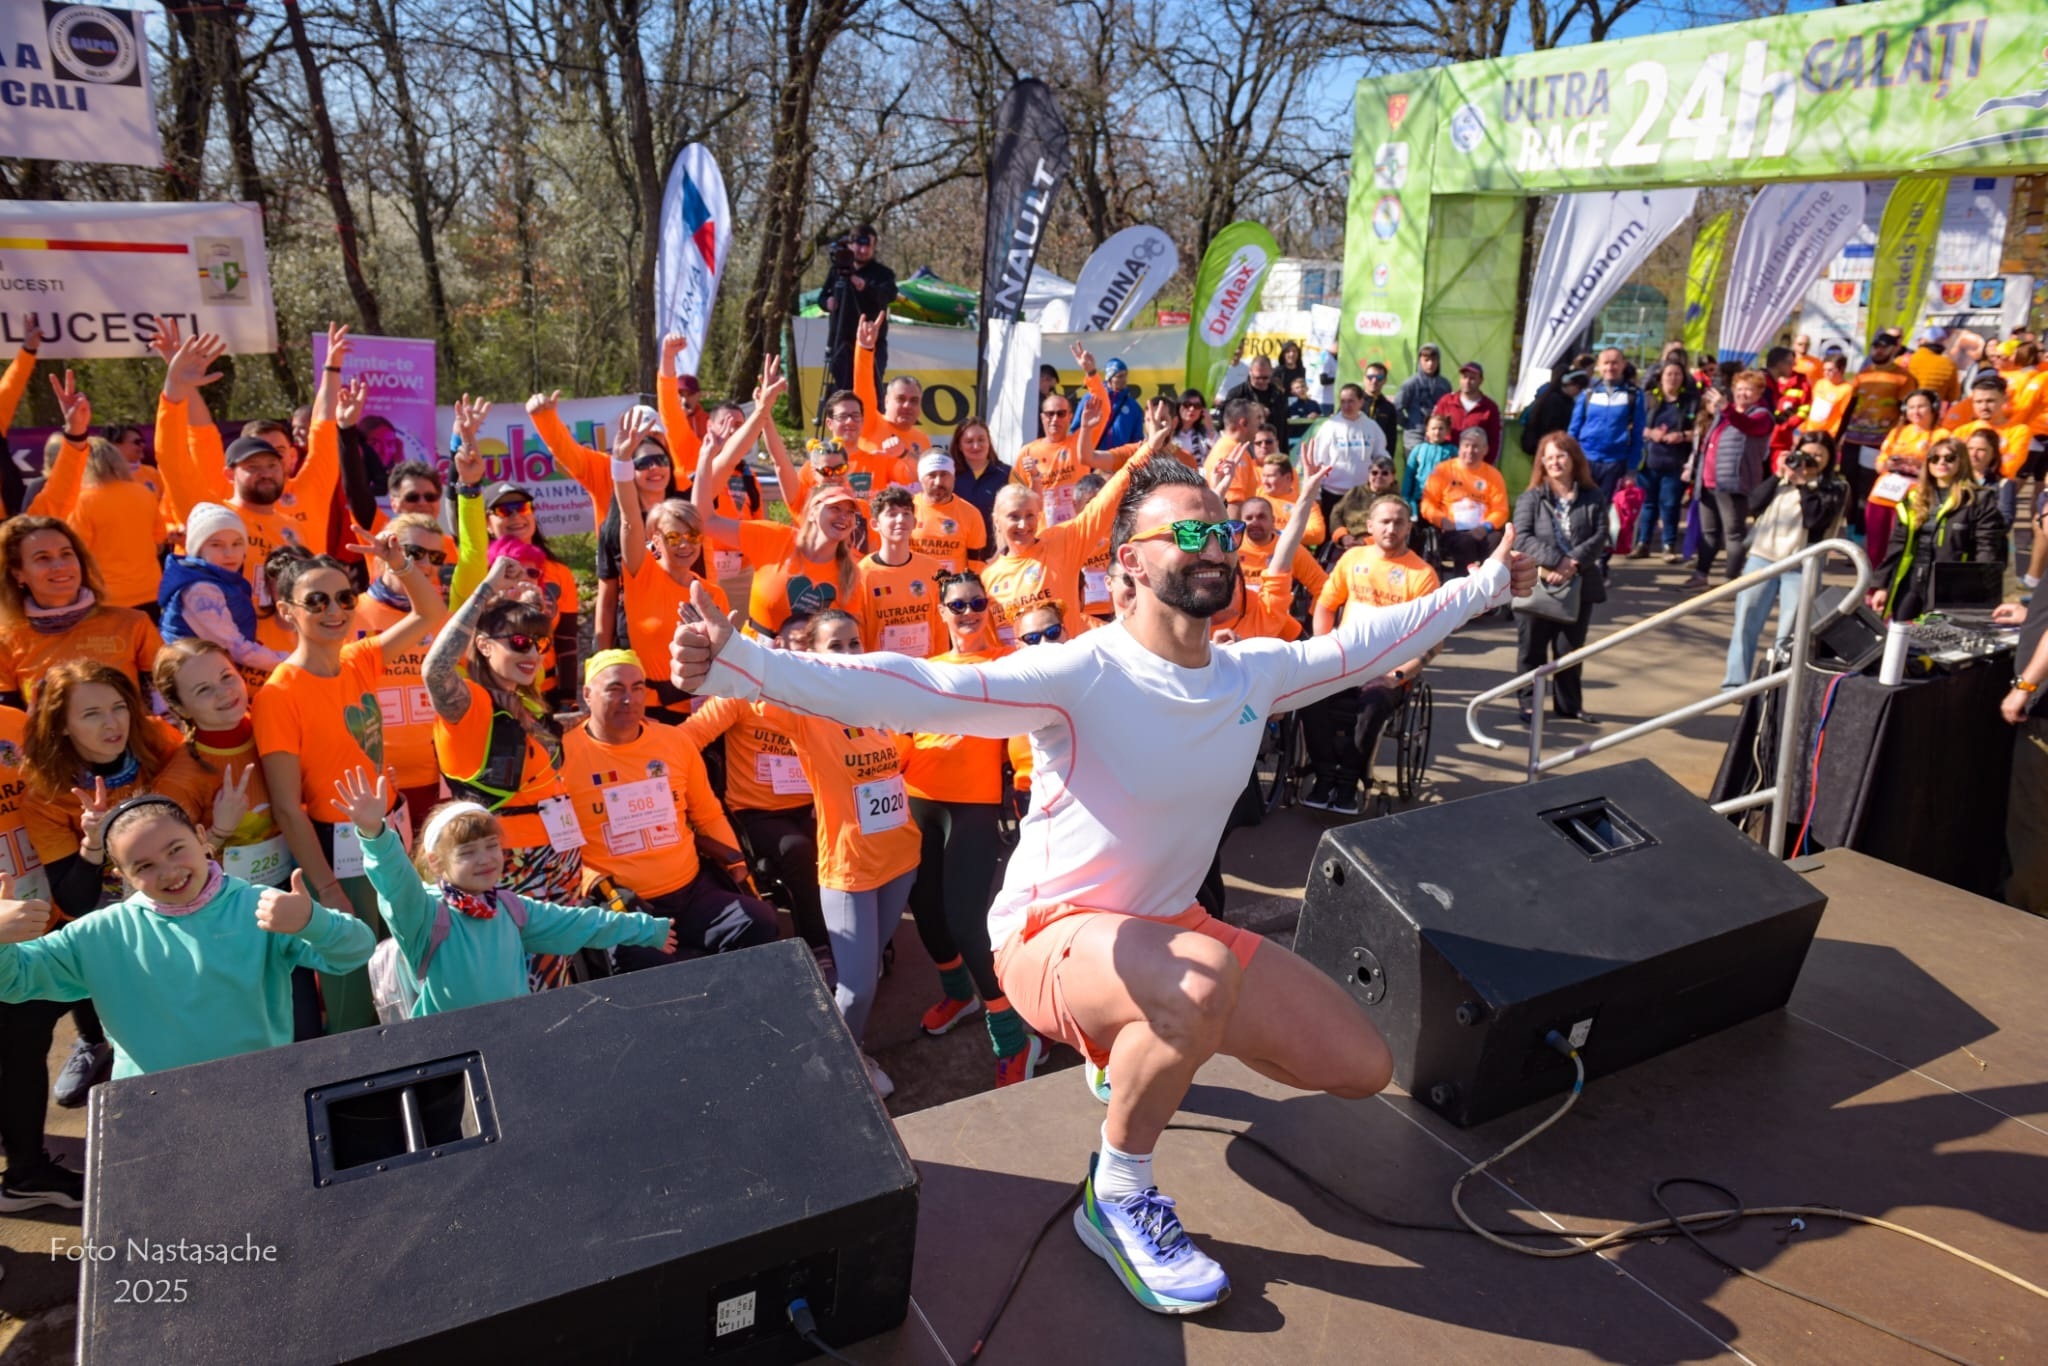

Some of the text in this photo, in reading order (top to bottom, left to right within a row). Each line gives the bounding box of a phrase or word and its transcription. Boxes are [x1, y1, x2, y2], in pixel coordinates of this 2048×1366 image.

[1801, 19, 1988, 99] GALAȚI
[1501, 67, 1611, 123] ULTRA
[1610, 40, 1797, 167] 24h
[1516, 119, 1608, 172] RACE
[1208, 265, 1255, 336] Dr.Max
[1549, 219, 1645, 336] Autonom
[364, 373, 424, 390] WOW!
[628, 797, 655, 813] 508
[869, 793, 905, 817] 2020
[251, 852, 280, 875] 228
